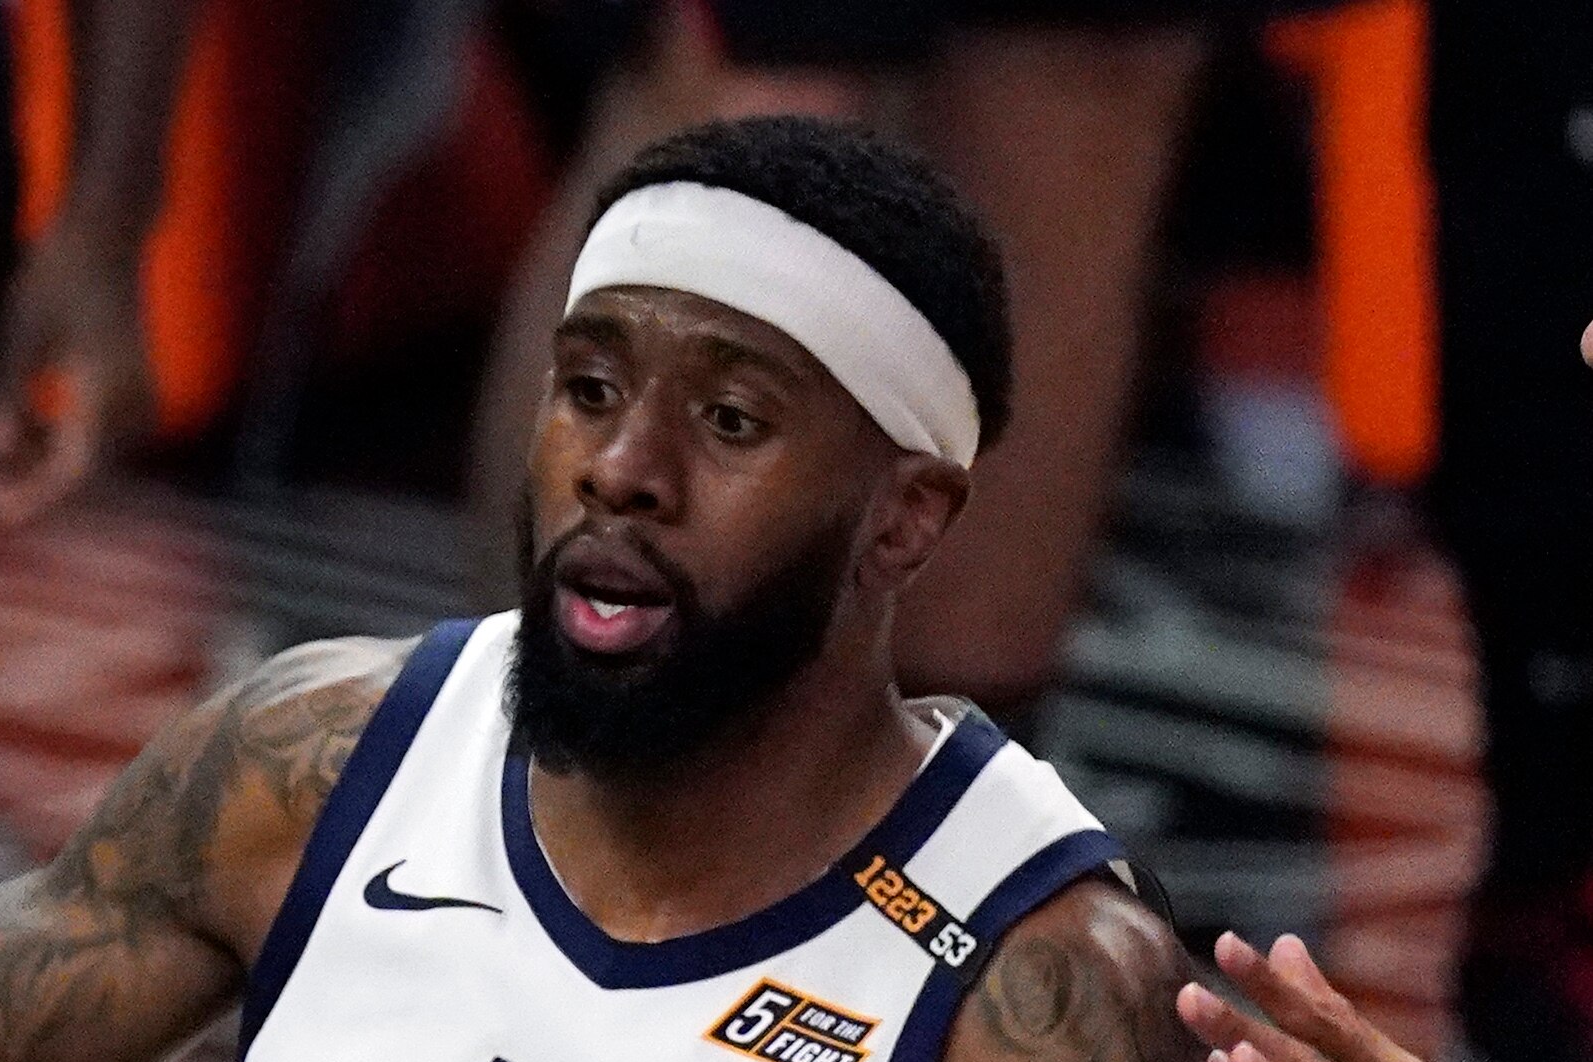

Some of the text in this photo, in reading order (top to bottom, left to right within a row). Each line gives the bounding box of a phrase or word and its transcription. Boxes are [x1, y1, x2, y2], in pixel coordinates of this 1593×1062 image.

[854, 855, 977, 967] 1223 53
[724, 989, 793, 1045] 5
[799, 1006, 867, 1042] FOR THE
